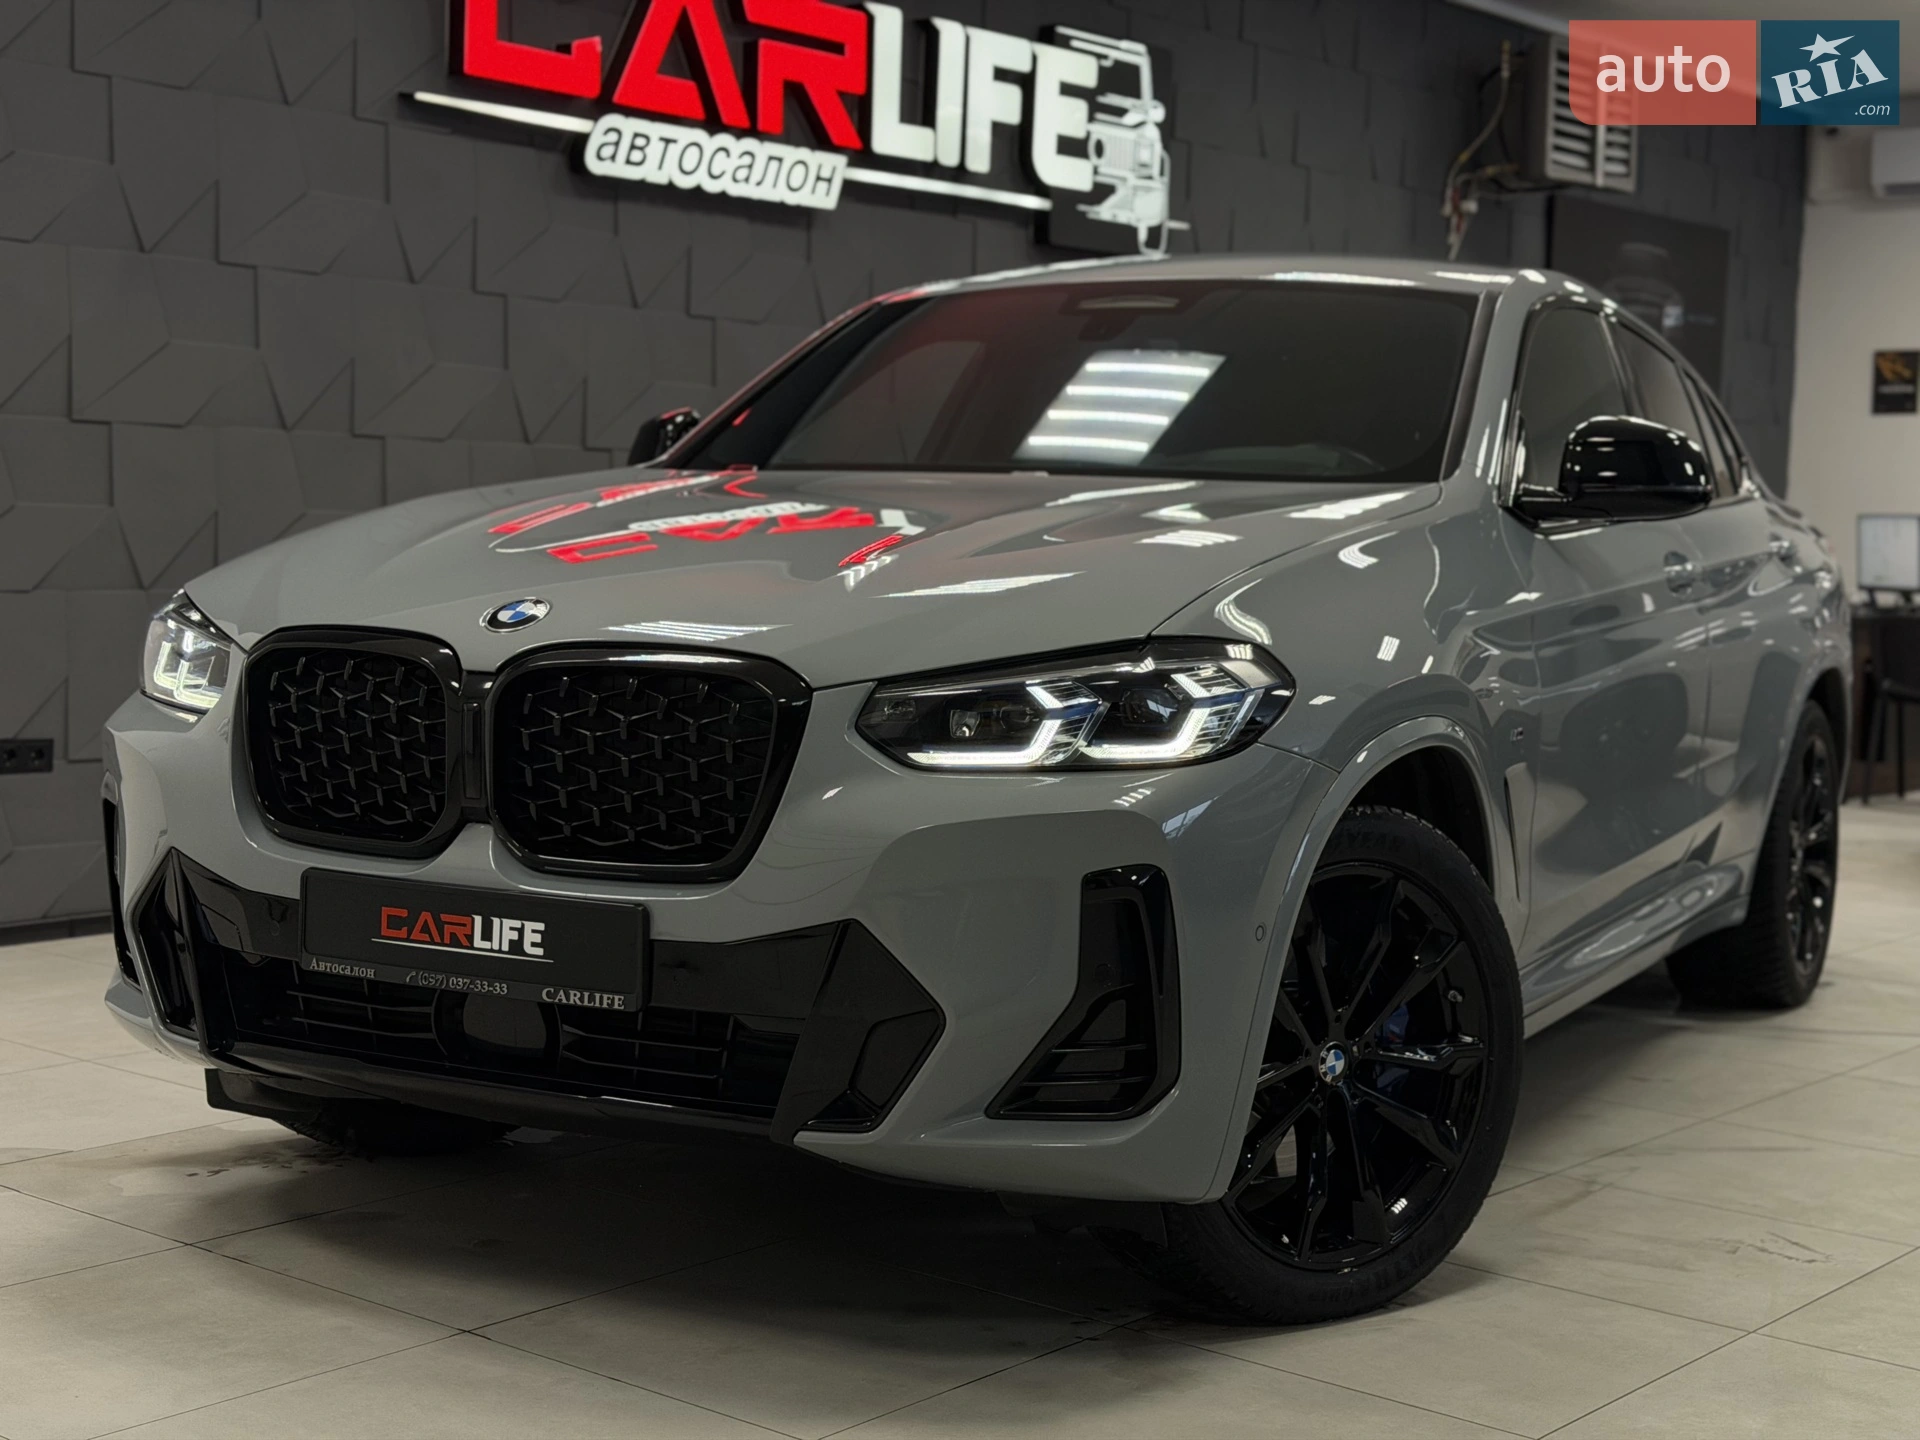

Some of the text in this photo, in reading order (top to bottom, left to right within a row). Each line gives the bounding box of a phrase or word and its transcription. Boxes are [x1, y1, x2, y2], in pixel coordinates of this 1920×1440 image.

[595, 126, 837, 198] автосалон
[380, 906, 546, 956] CARLIFE
[309, 956, 376, 979] Автосалон
[449, 976, 508, 995] 037-33-33
[541, 987, 625, 1010] CARLIFE
